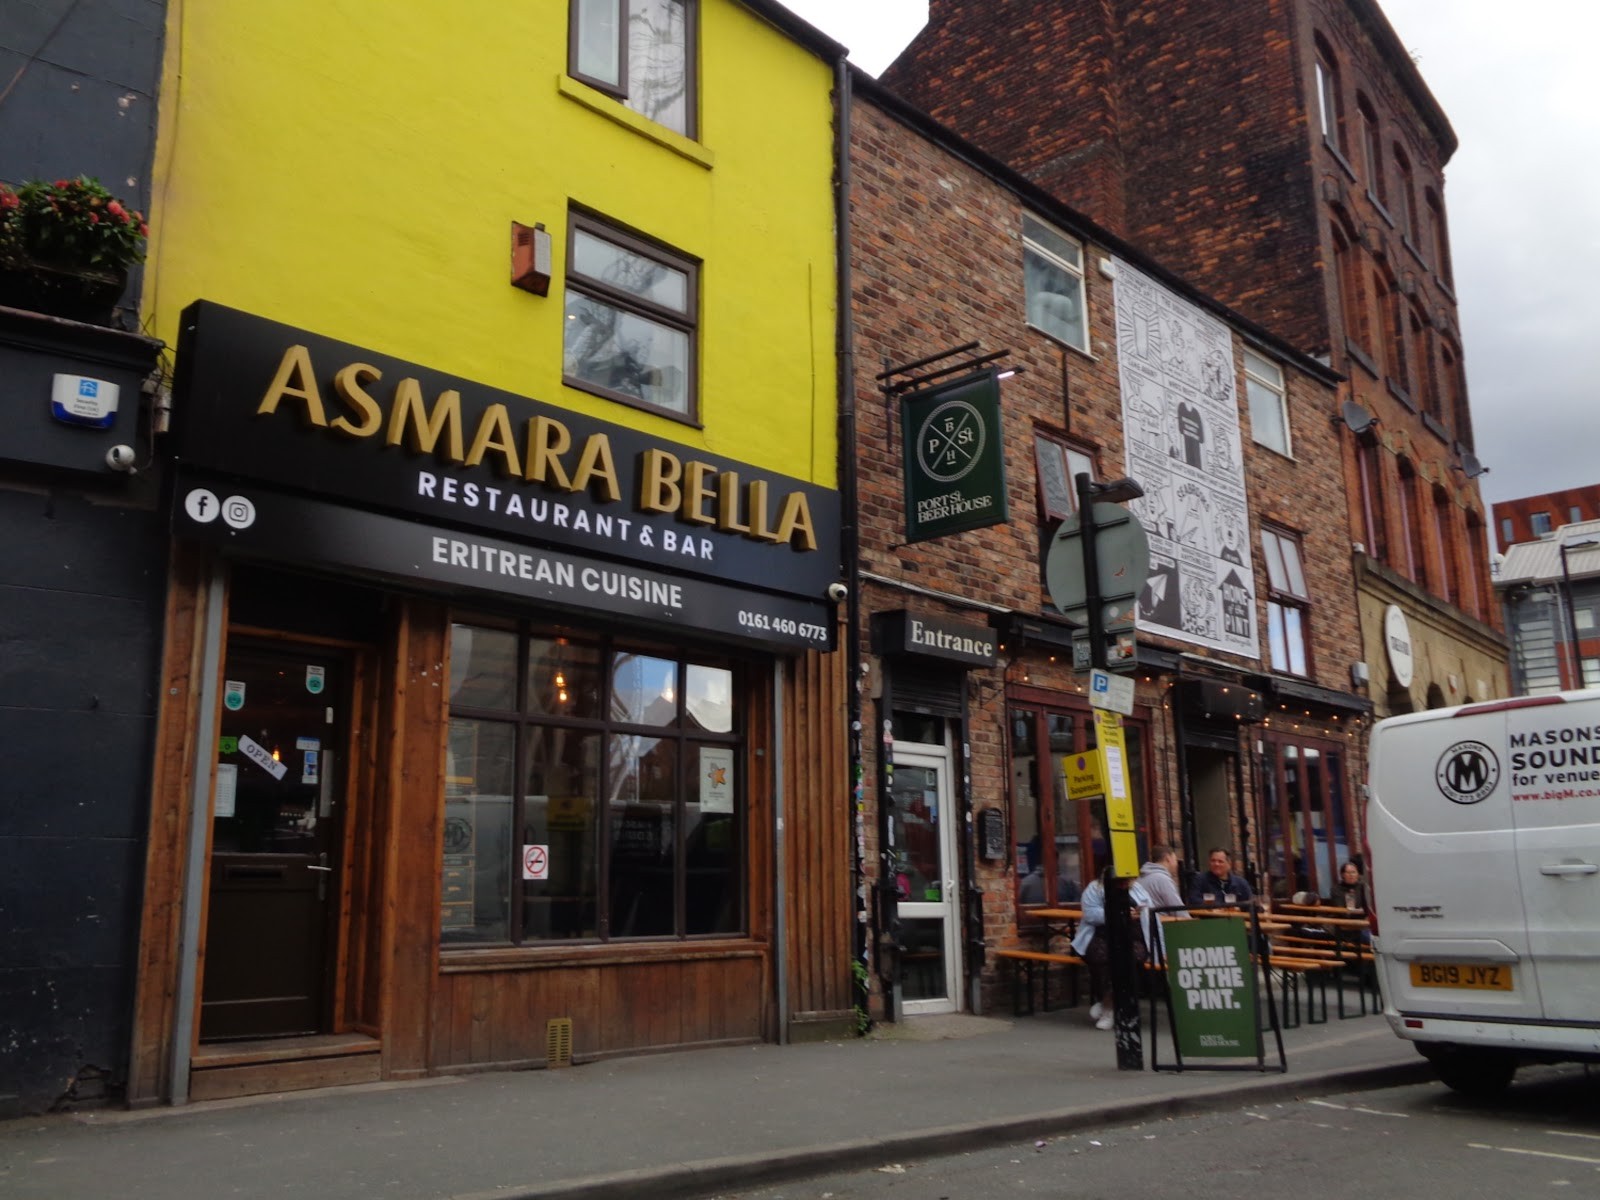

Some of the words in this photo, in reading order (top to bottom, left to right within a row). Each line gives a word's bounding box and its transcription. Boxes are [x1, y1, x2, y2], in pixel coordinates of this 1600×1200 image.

[256, 344, 621, 501] ASMARA
[641, 447, 818, 551] BELLA
[917, 494, 949, 513] PORT
[918, 506, 950, 523] BEER
[950, 495, 993, 516] HOUSE
[417, 471, 631, 542] RESTAURANT
[639, 524, 654, 547] &
[662, 529, 714, 560] BAR
[432, 536, 575, 588] ERITREAN
[581, 567, 683, 609] CUISINE
[1223, 582, 1248, 606] HOME
[738, 610, 771, 630] 0161
[772, 617, 796, 635] 460
[798, 623, 827, 641] 6773
[1225, 613, 1249, 637] PINT
[911, 620, 992, 657] Entrance
[1097, 676, 1107, 690] P
[246, 744, 278, 771] OPEN
[1070, 784, 1101, 795] Suspension
[1073, 774, 1095, 783] Parking
[1513, 773, 1537, 787] for
[1178, 946, 1237, 968] HOME
[1177, 968, 1203, 989] OF
[1203, 967, 1245, 988] THE
[1420, 965, 1459, 984] BG19
[1466, 966, 1502, 986] JYZ
[1186, 988, 1241, 1010] PINT.
